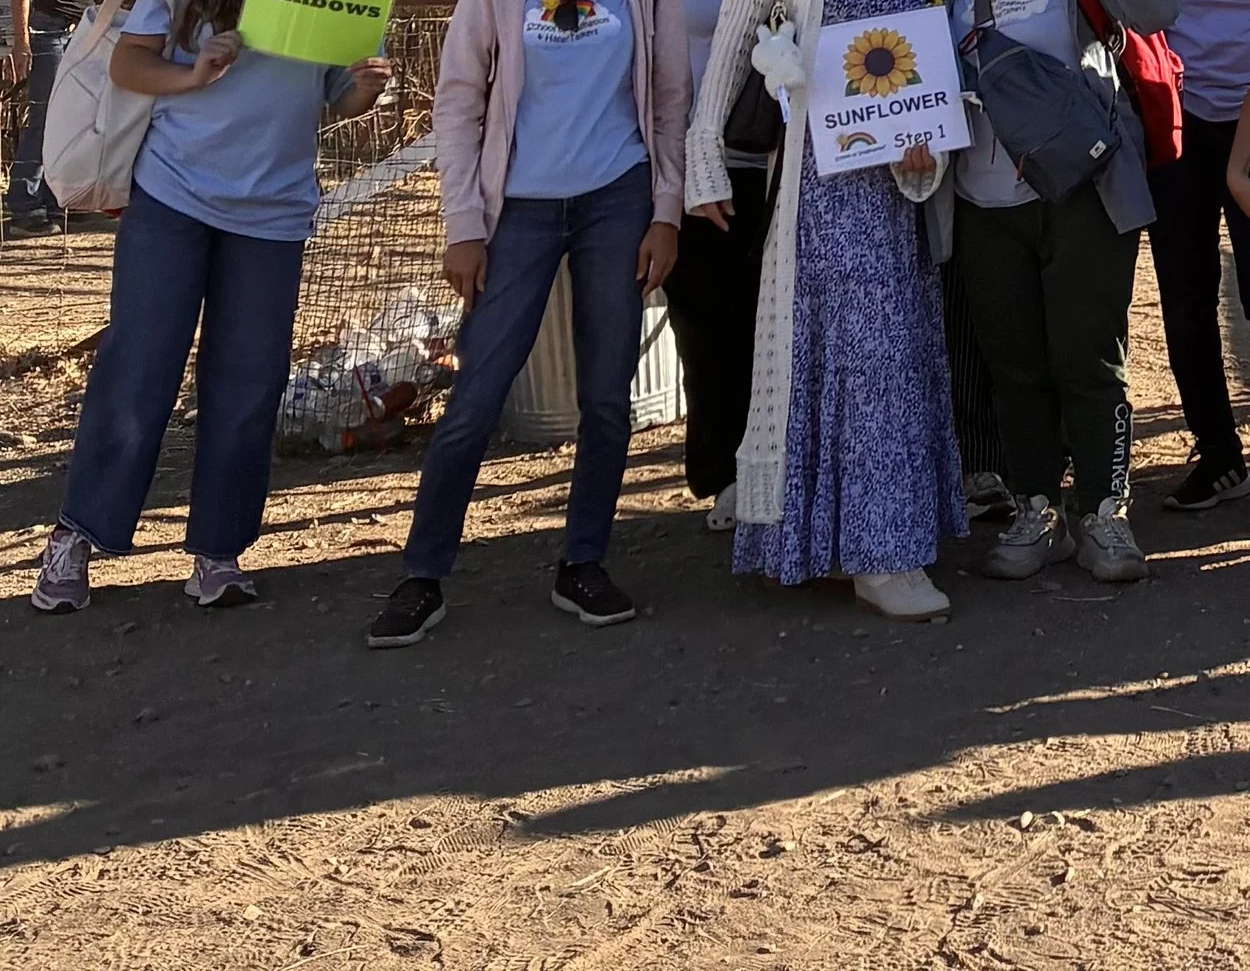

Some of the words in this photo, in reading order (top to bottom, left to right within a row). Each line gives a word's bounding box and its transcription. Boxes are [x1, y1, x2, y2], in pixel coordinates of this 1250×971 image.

[824, 91, 948, 129] SUNFLOWER
[894, 130, 932, 148] Step
[937, 124, 946, 139] 1
